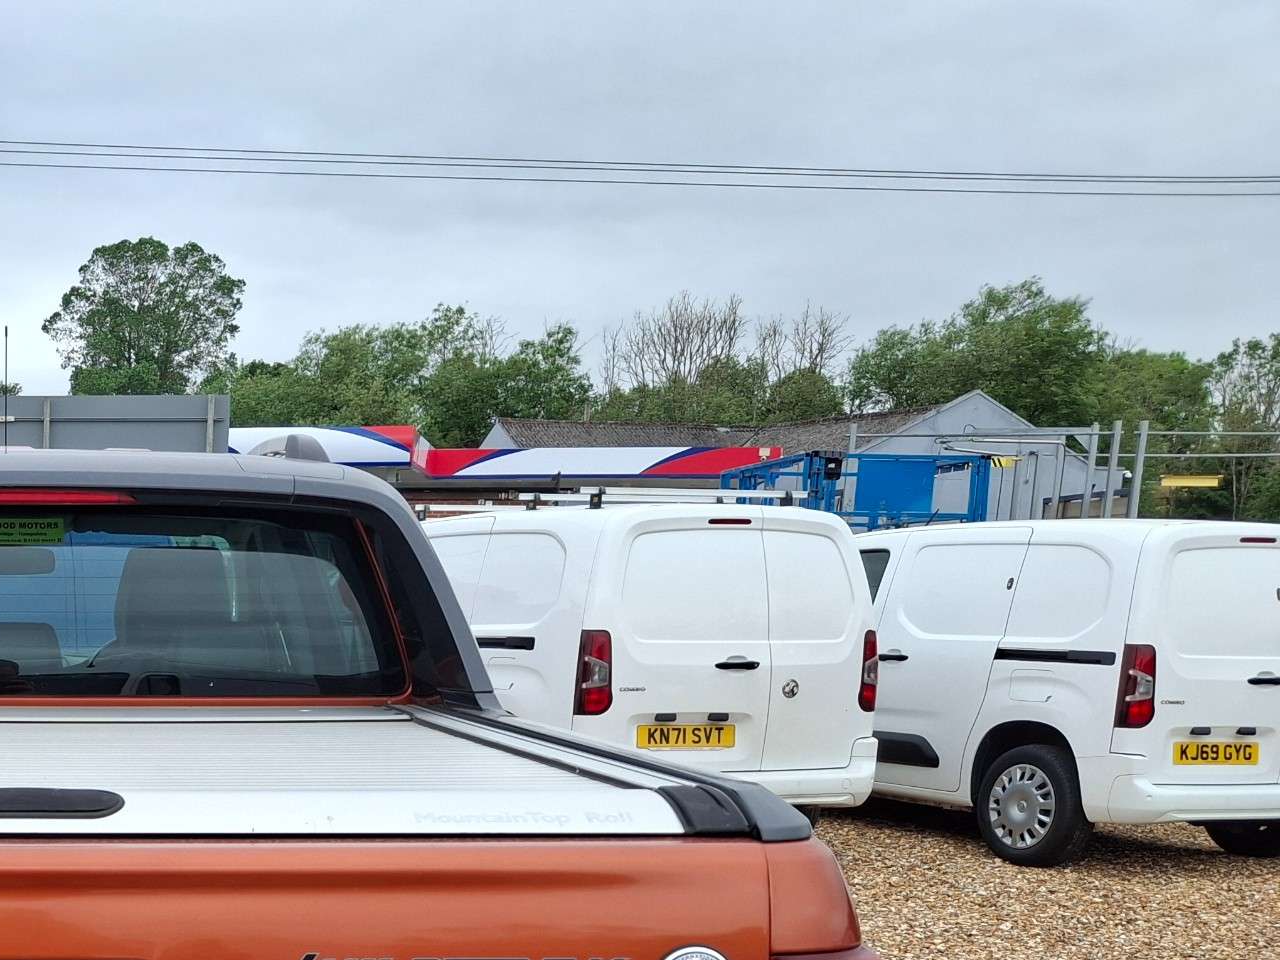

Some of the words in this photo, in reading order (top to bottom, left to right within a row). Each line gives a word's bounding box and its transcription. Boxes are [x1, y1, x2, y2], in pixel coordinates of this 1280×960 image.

[19, 522, 59, 530] MOTORS
[647, 727, 687, 744] KN71
[691, 727, 725, 744] SVT
[1180, 744, 1220, 760] KJ69
[1223, 745, 1252, 760] GYG
[413, 811, 570, 825] MountainTop
[585, 812, 633, 823] Roll
